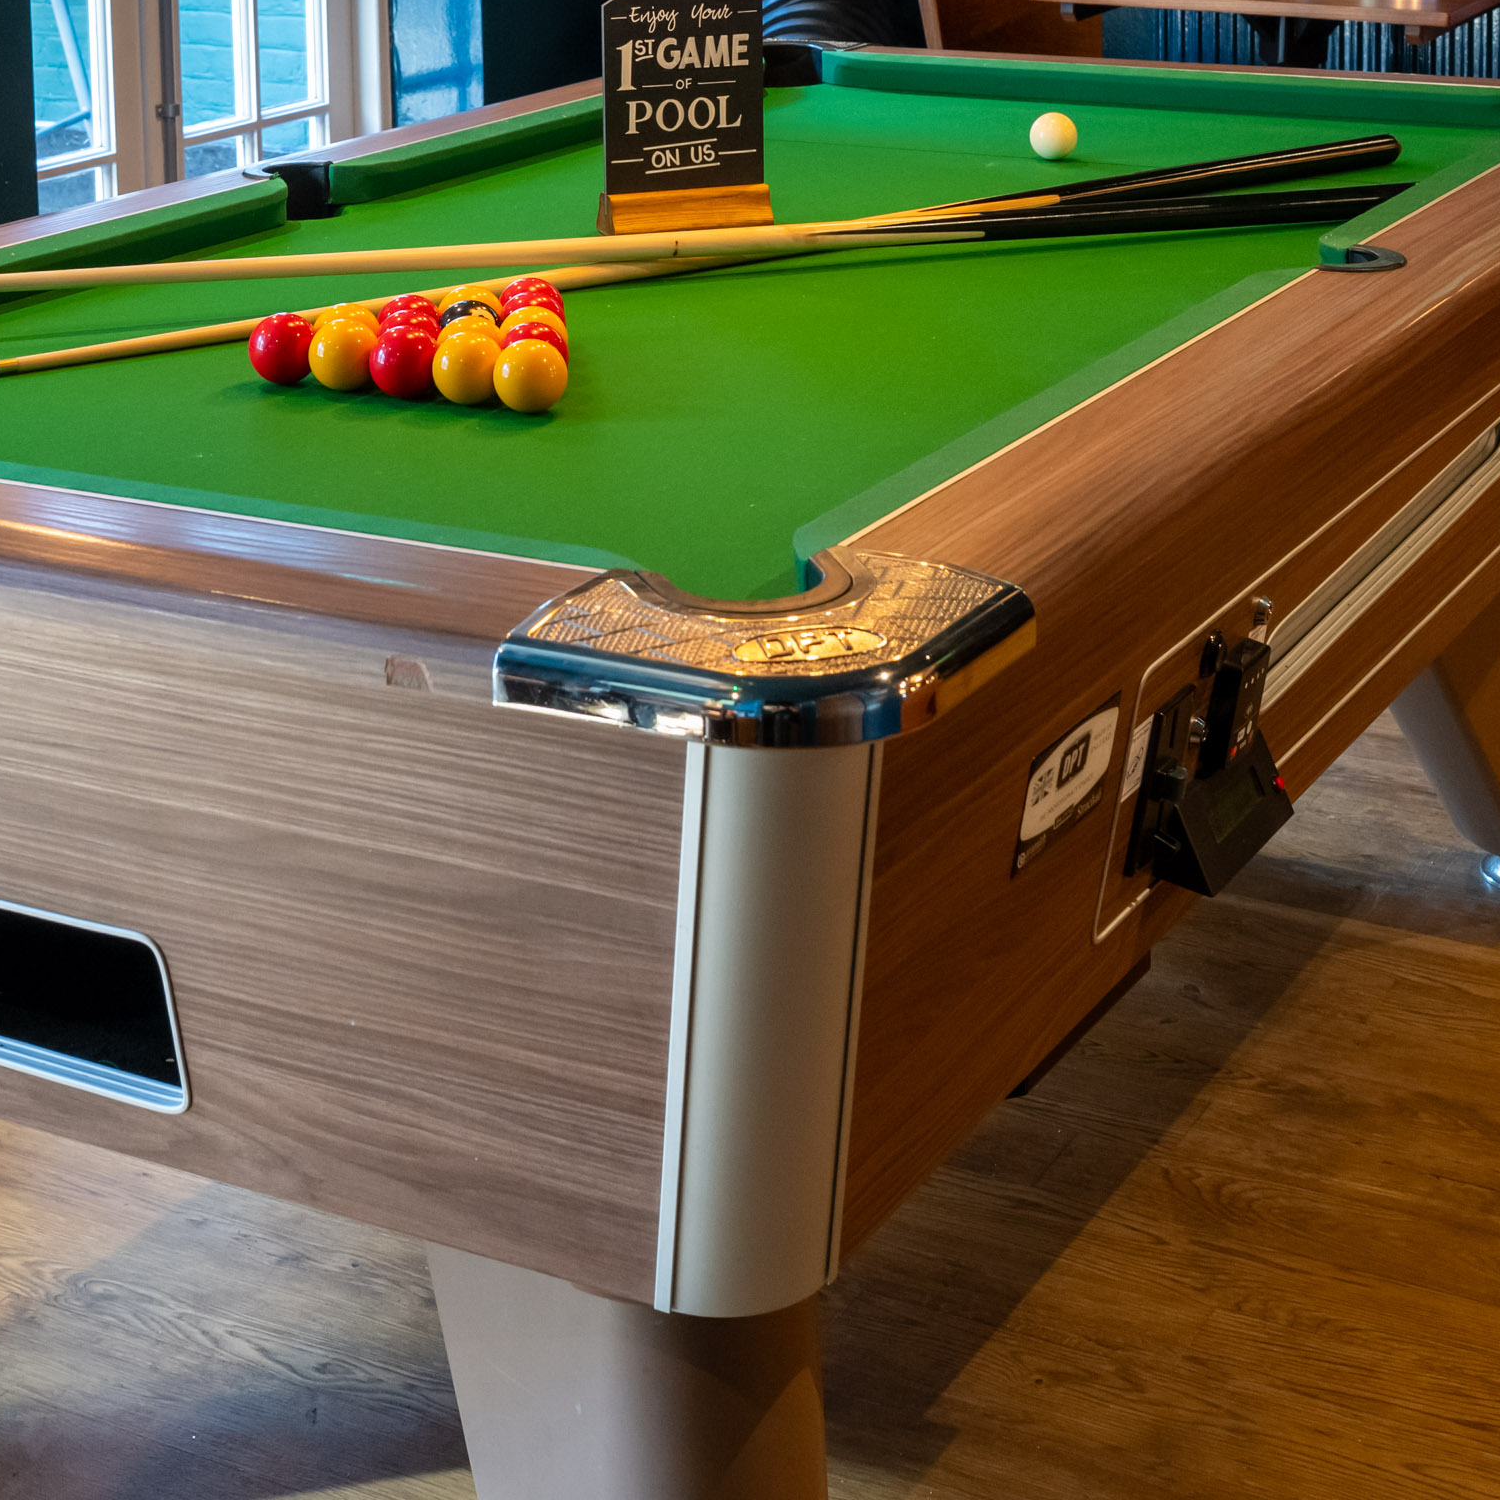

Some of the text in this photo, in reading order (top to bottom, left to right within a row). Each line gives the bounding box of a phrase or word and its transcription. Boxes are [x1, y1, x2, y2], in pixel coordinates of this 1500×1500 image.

[628, 2, 733, 34] Enjoy Your
[656, 33, 750, 71] GAME
[675, 78, 693, 91] OF
[625, 94, 743, 136] POOL
[651, 144, 716, 170] ON US
[1062, 741, 1087, 780] DPT
